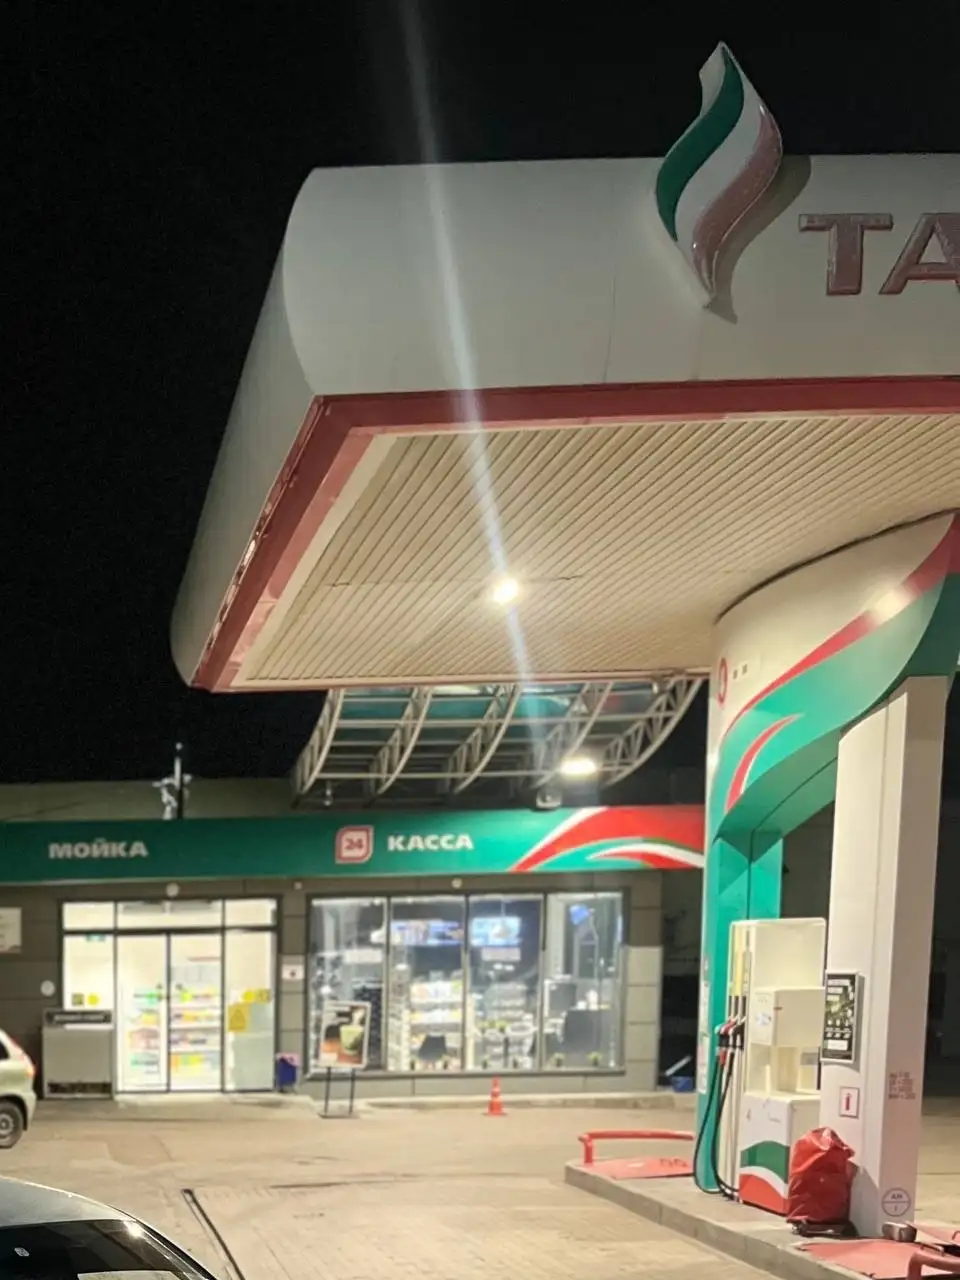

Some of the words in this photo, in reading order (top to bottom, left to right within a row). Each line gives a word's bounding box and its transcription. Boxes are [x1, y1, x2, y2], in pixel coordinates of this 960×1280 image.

[47, 837, 149, 859] МОЙКА
[344, 837, 364, 851] 24
[386, 832, 474, 852] КАССА
